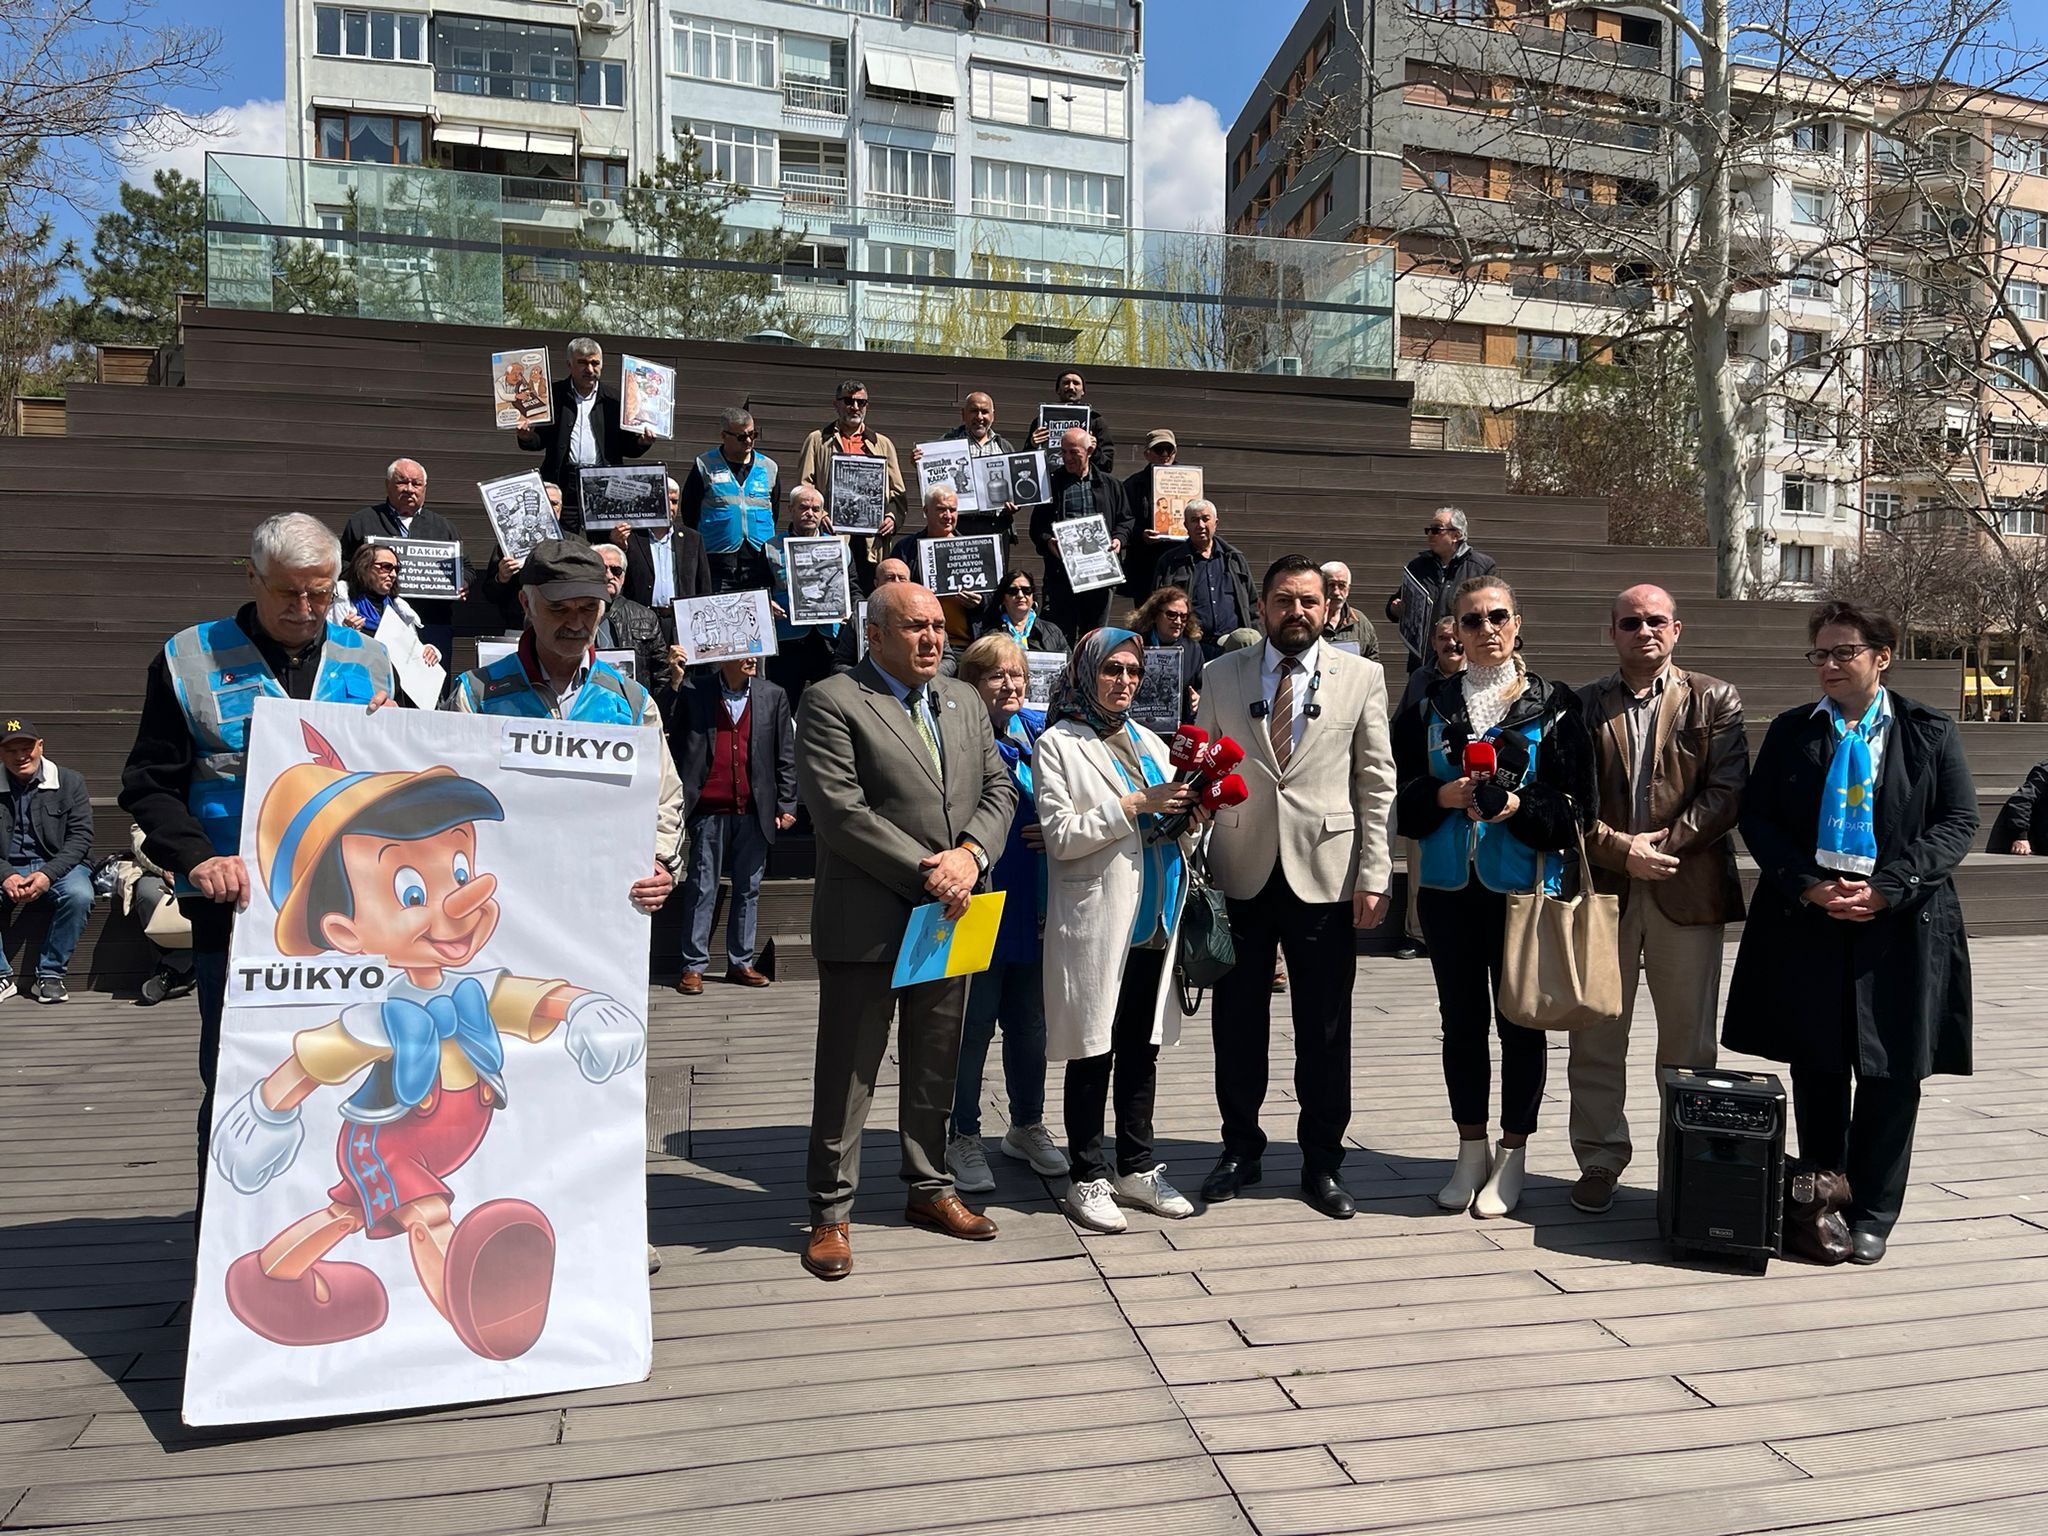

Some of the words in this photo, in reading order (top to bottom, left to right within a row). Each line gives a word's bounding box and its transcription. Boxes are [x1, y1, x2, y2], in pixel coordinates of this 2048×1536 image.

[955, 539, 993, 547] ORTAMINDA
[946, 560, 984, 568] ENFLASYON
[947, 573, 988, 592] 1,94
[509, 730, 634, 762] TÜİKYO
[238, 962, 384, 992] TÜİKYO
